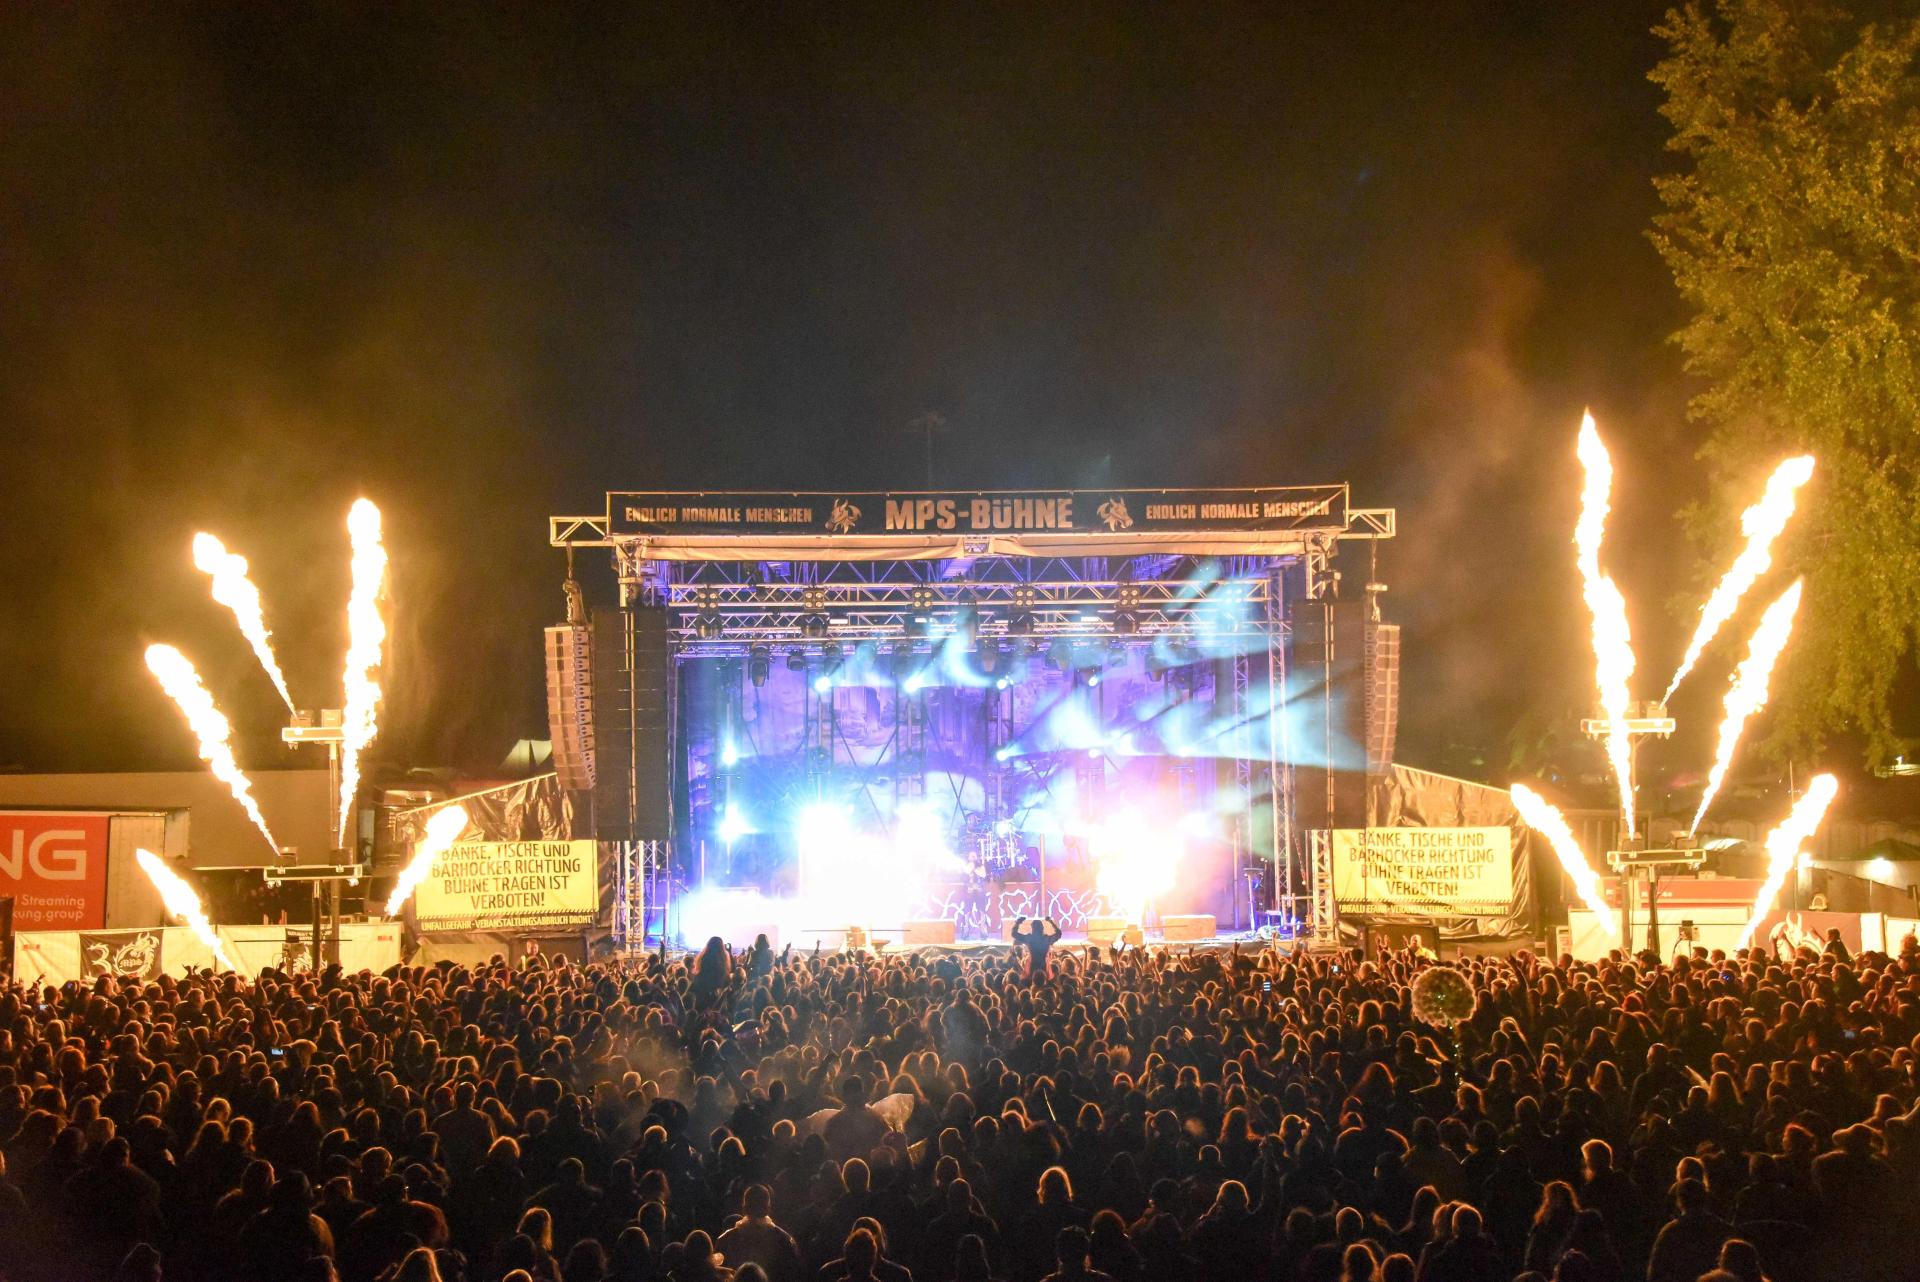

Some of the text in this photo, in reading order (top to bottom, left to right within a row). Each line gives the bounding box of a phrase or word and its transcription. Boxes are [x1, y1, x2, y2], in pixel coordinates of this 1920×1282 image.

[626, 507, 812, 523] ENDLICH NORMALE MENSCHEN
[885, 498, 1073, 530] MPS-BÜHNE
[1146, 501, 1330, 519] ENDLICH NORMALE MENSCHEN
[1410, 832, 1453, 847] TISCHE
[1457, 833, 1485, 846] UND
[495, 843, 539, 858] TISCHE
[542, 843, 571, 857] UND
[1350, 848, 1495, 863] BARHOCKER RICHTUNG
[432, 858, 581, 878] BARHOCKER RICHTUNG
[1407, 865, 1459, 880] TRAGEN
[1463, 865, 1483, 879] IST
[492, 875, 546, 891] TRAGEN
[549, 875, 570, 890] IST
[1386, 881, 1459, 896] VERBOTEN!
[21, 894, 85, 909] Streaming
[470, 892, 545, 910] VERBOTEN!
